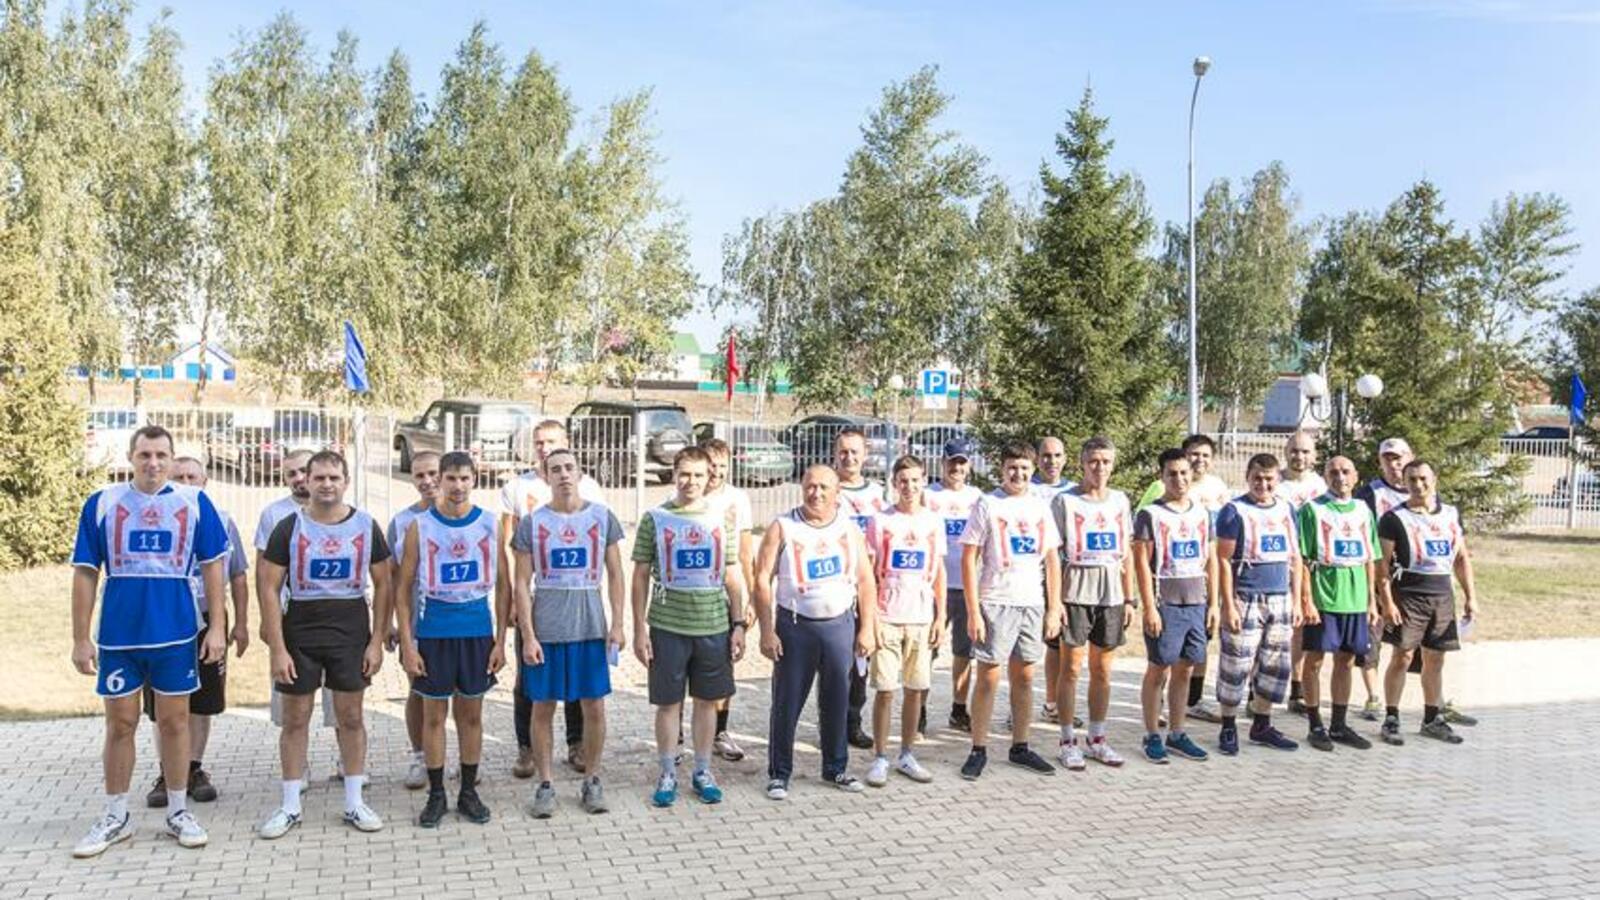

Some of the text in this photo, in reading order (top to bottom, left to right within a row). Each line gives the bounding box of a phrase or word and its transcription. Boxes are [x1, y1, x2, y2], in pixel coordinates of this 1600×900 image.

[929, 372, 943, 393] P
[138, 533, 161, 550] 11
[1094, 535, 1111, 549] 13
[1341, 541, 1358, 555] 28
[560, 551, 579, 566] 12
[684, 551, 705, 567] 38
[899, 552, 918, 568] 36
[319, 561, 342, 577] 22
[449, 564, 470, 581] 17
[815, 560, 834, 577] 10
[106, 668, 125, 693] 6
